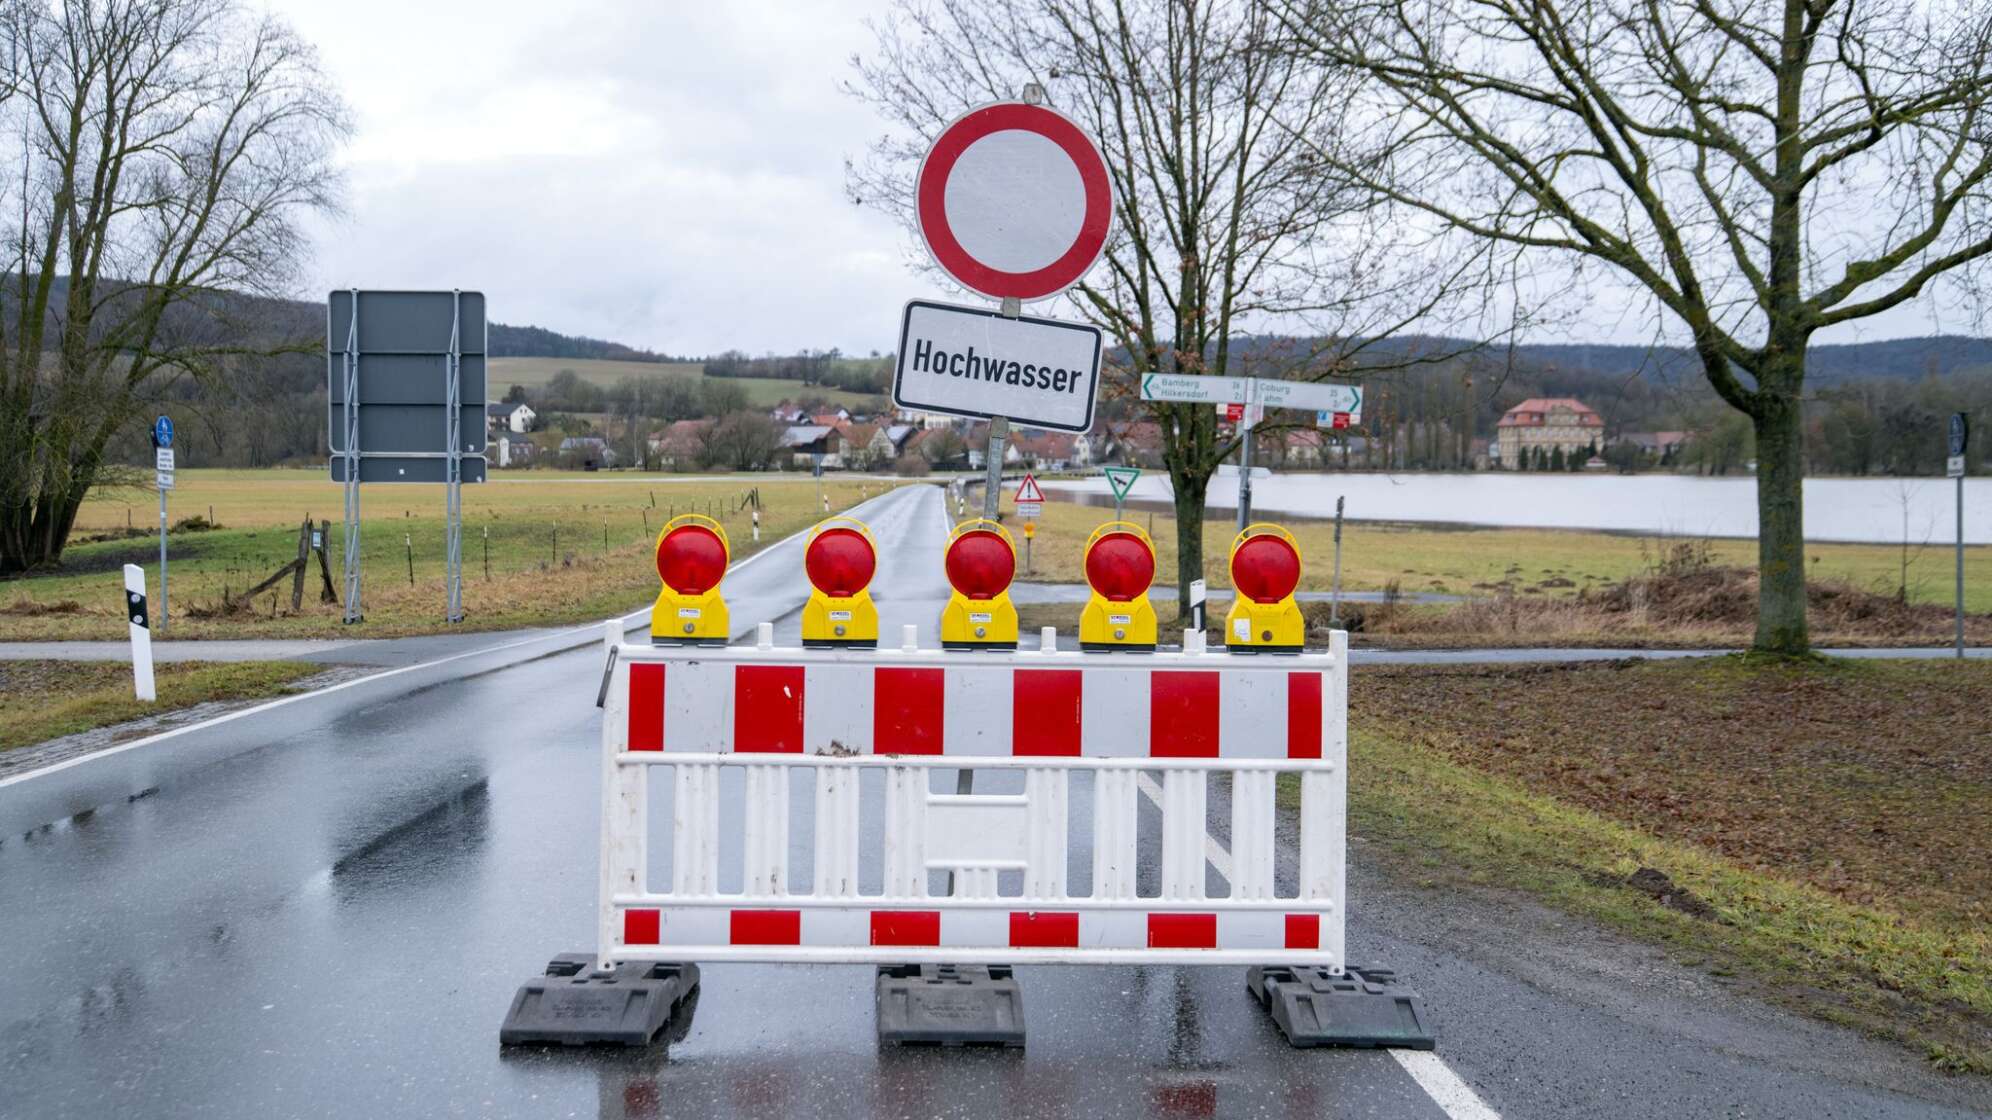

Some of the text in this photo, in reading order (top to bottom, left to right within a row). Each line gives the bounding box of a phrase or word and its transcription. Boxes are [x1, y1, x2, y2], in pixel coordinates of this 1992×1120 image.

[912, 339, 1082, 393] Hochwasser
[1161, 378, 1200, 389] Bamberg
[1259, 383, 1291, 394] Coburg
[1264, 393, 1283, 402] ahm
